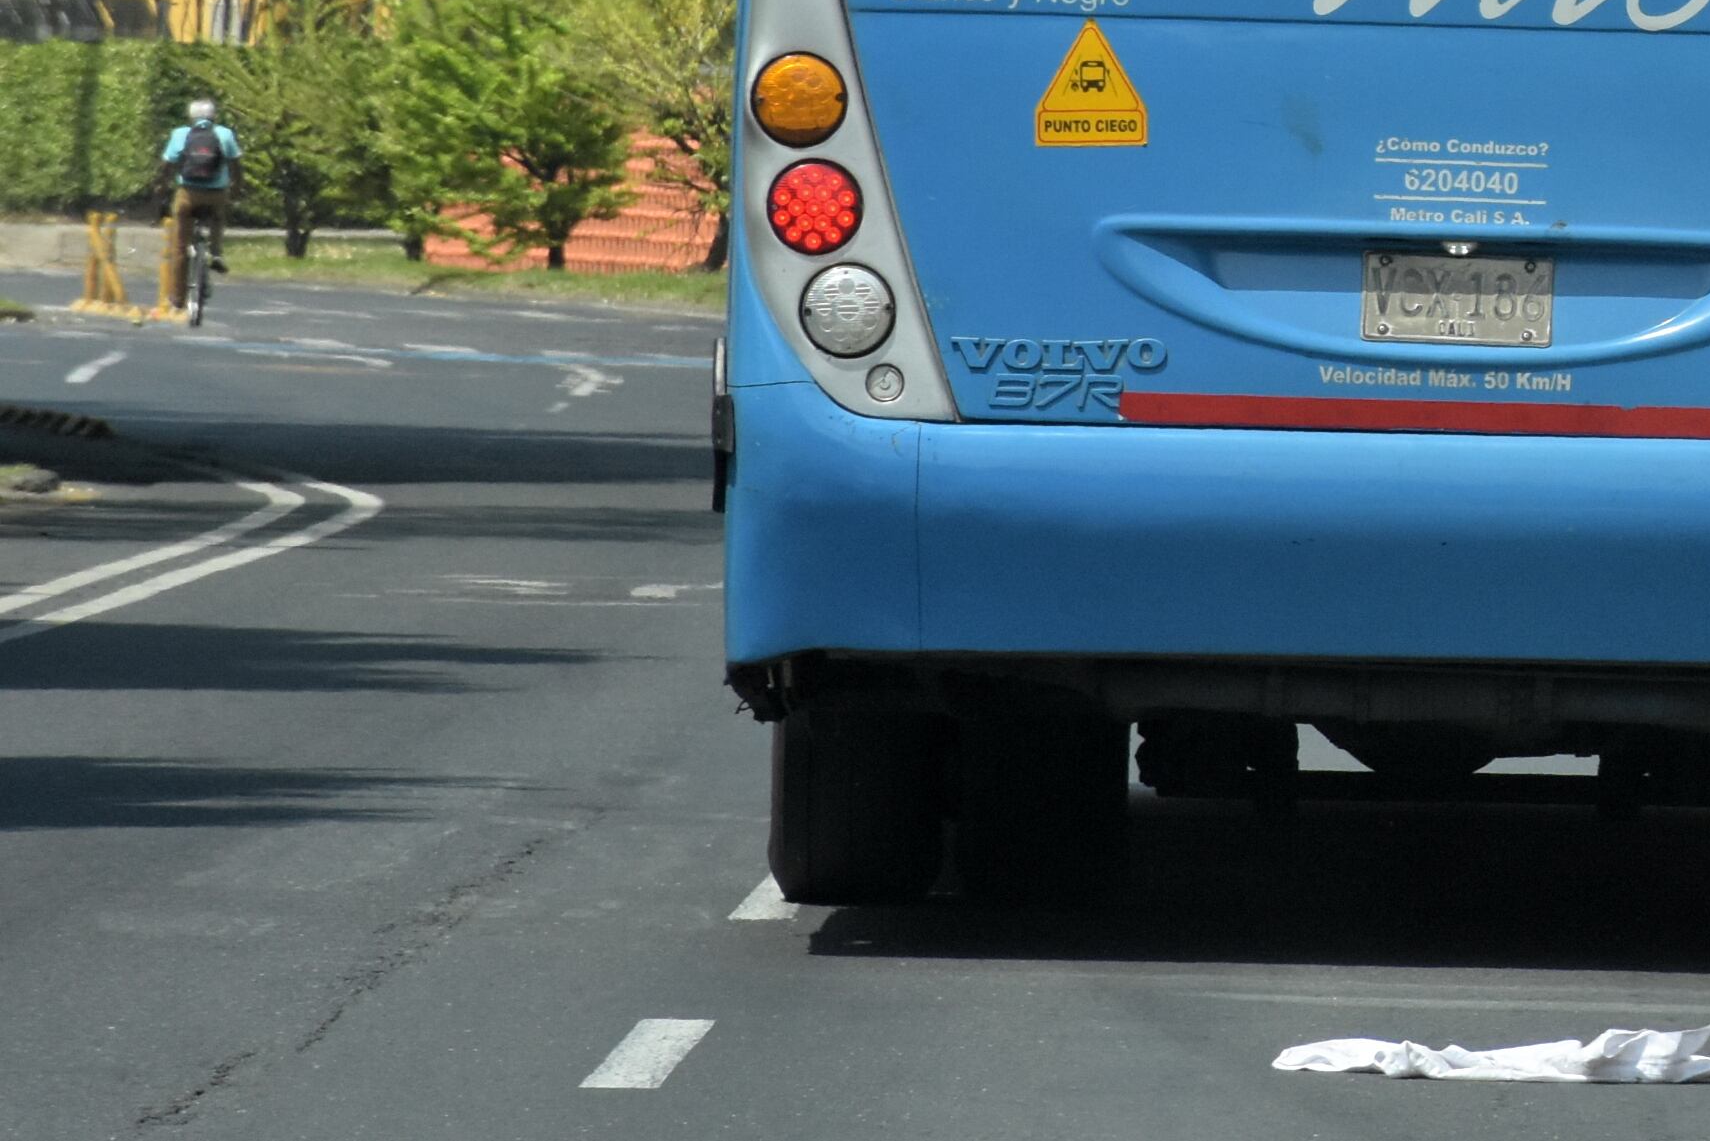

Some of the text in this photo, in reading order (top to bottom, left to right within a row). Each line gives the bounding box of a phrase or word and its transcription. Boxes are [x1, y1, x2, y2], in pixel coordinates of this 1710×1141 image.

[1044, 120, 1138, 132] PUNTO CIEGO
[1447, 139, 1549, 156] Conduzco?
[1405, 169, 1519, 195] 6204040
[1390, 207, 1445, 222] Metro
[1451, 209, 1488, 224] Cali
[1438, 320, 1476, 337] CALI
[951, 336, 1168, 372] VOLVO
[1319, 365, 1572, 391] Velocidad Máx. 50 Km/H
[988, 373, 1124, 411] B7R
